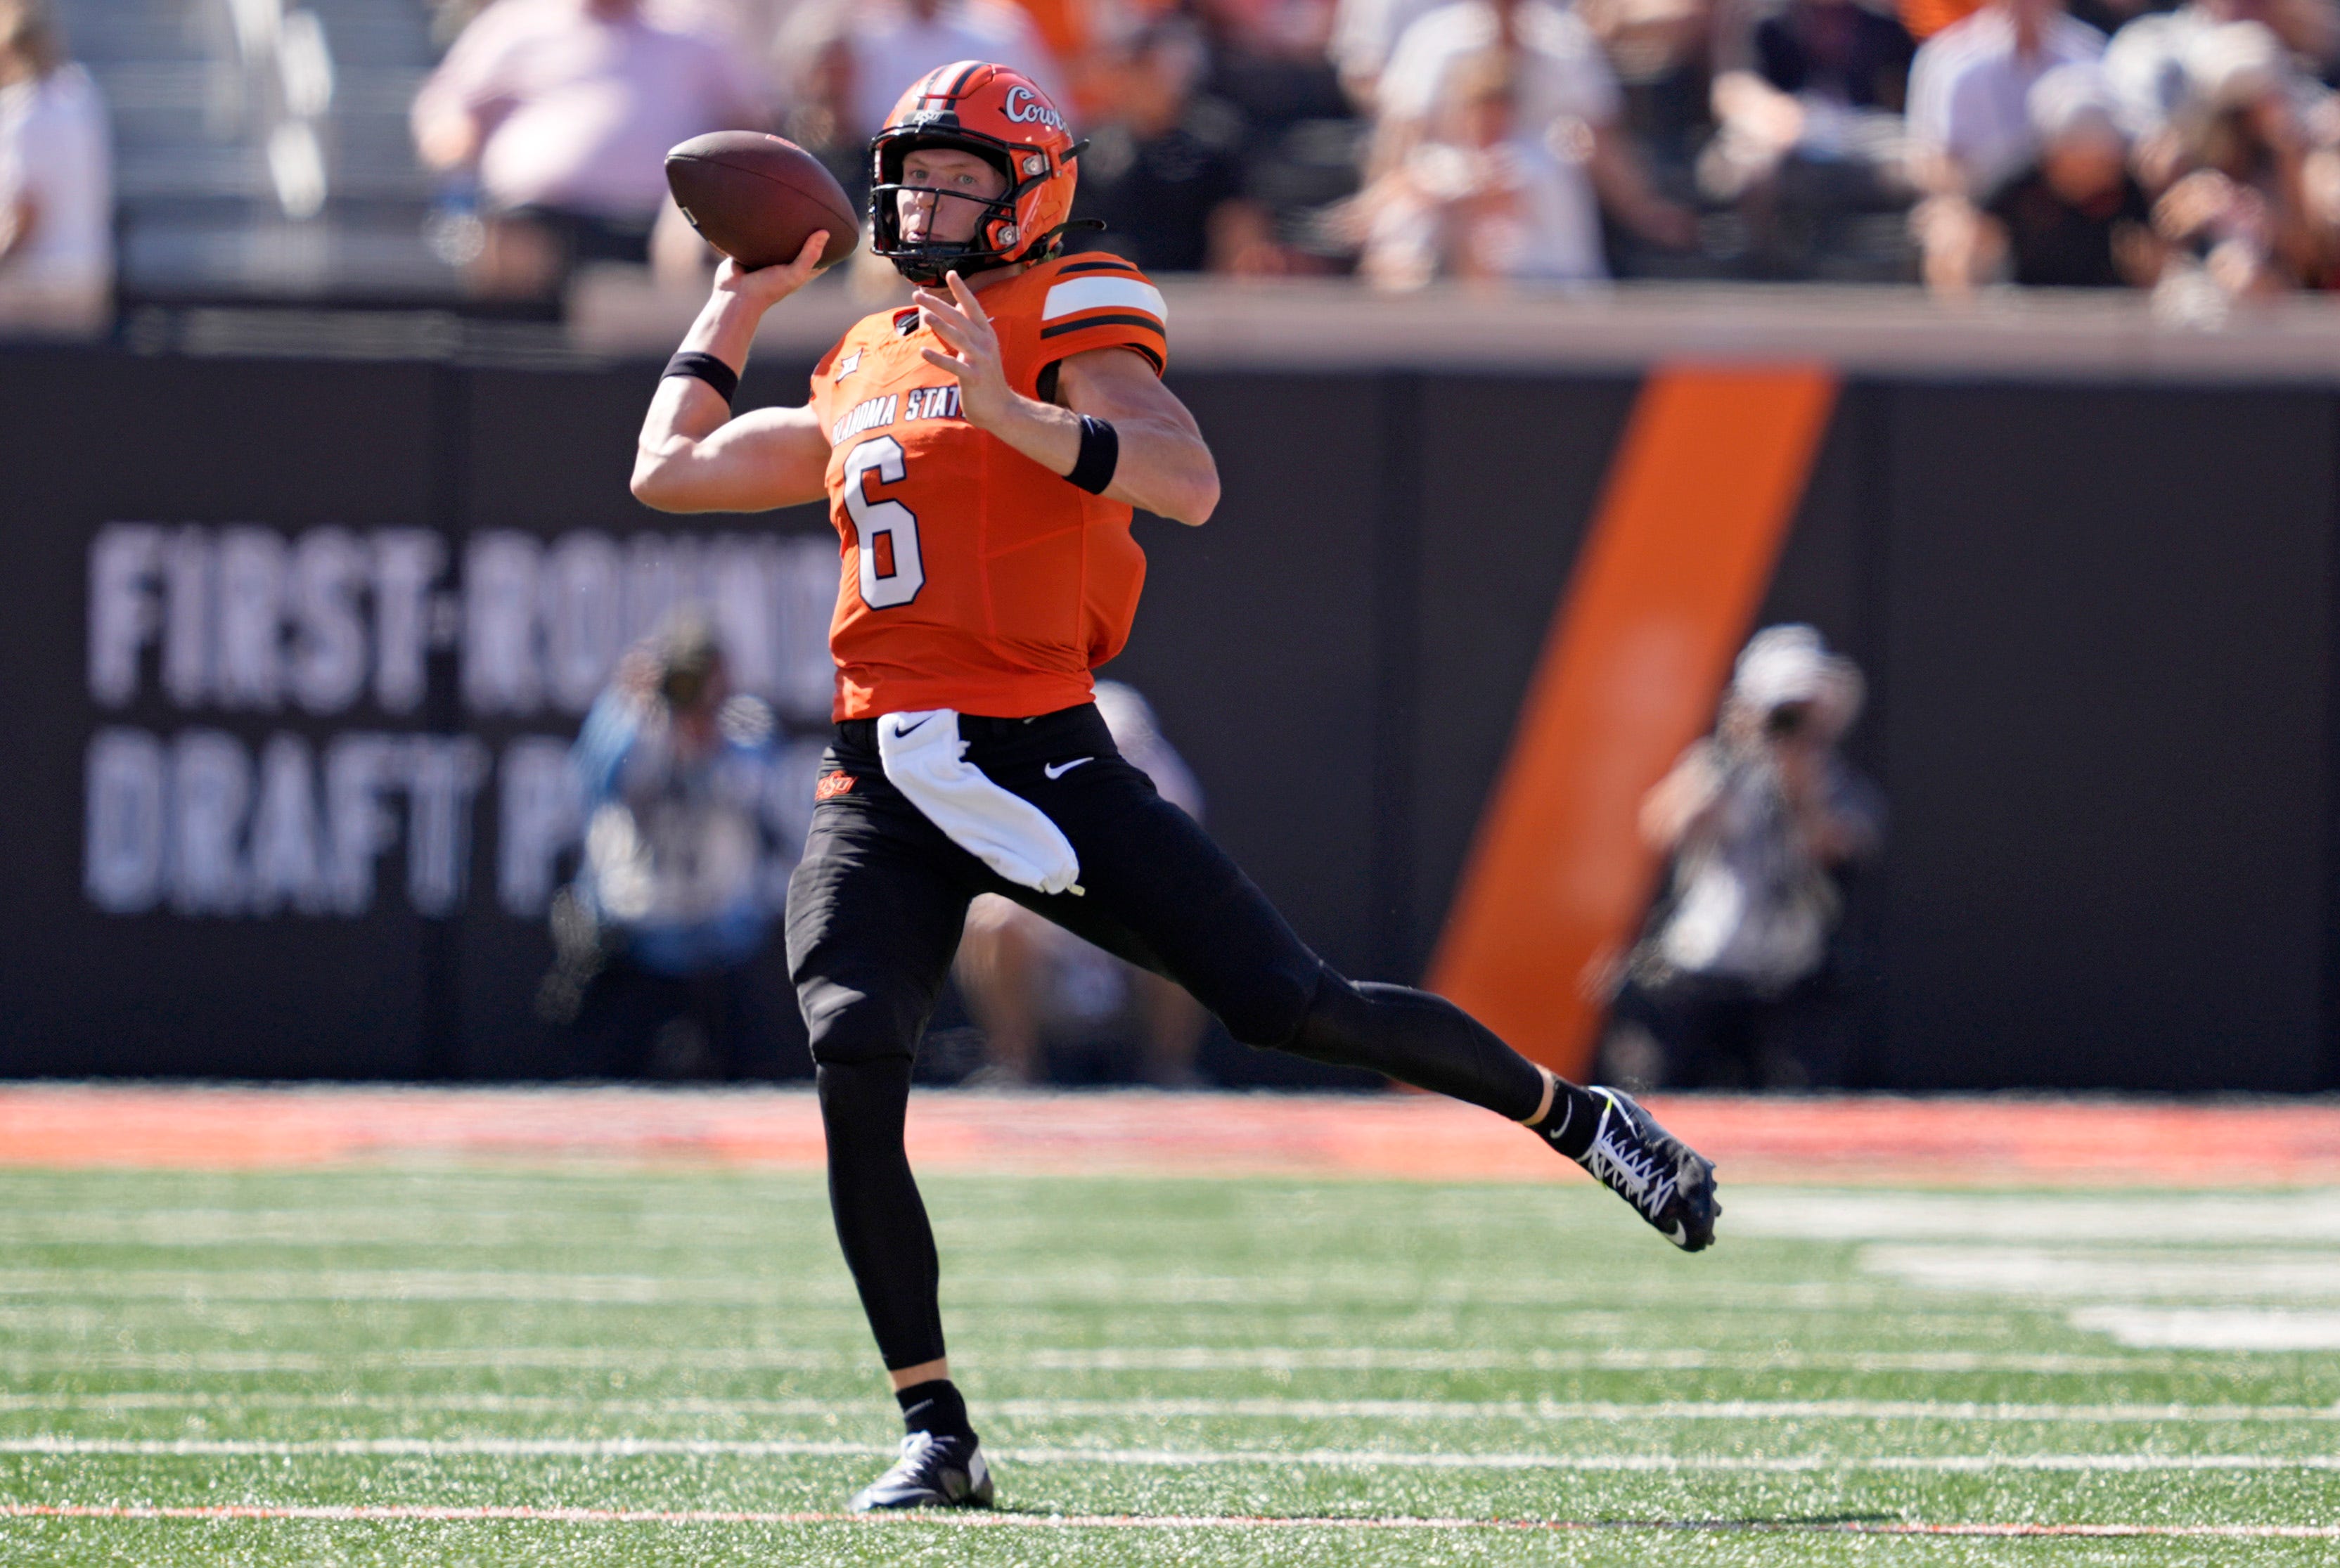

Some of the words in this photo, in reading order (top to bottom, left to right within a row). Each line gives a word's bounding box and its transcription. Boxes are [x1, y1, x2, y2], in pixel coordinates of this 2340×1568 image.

[904, 384, 967, 422] STAT
[843, 434, 926, 611] 6
[89, 735, 478, 904] DRAFT
